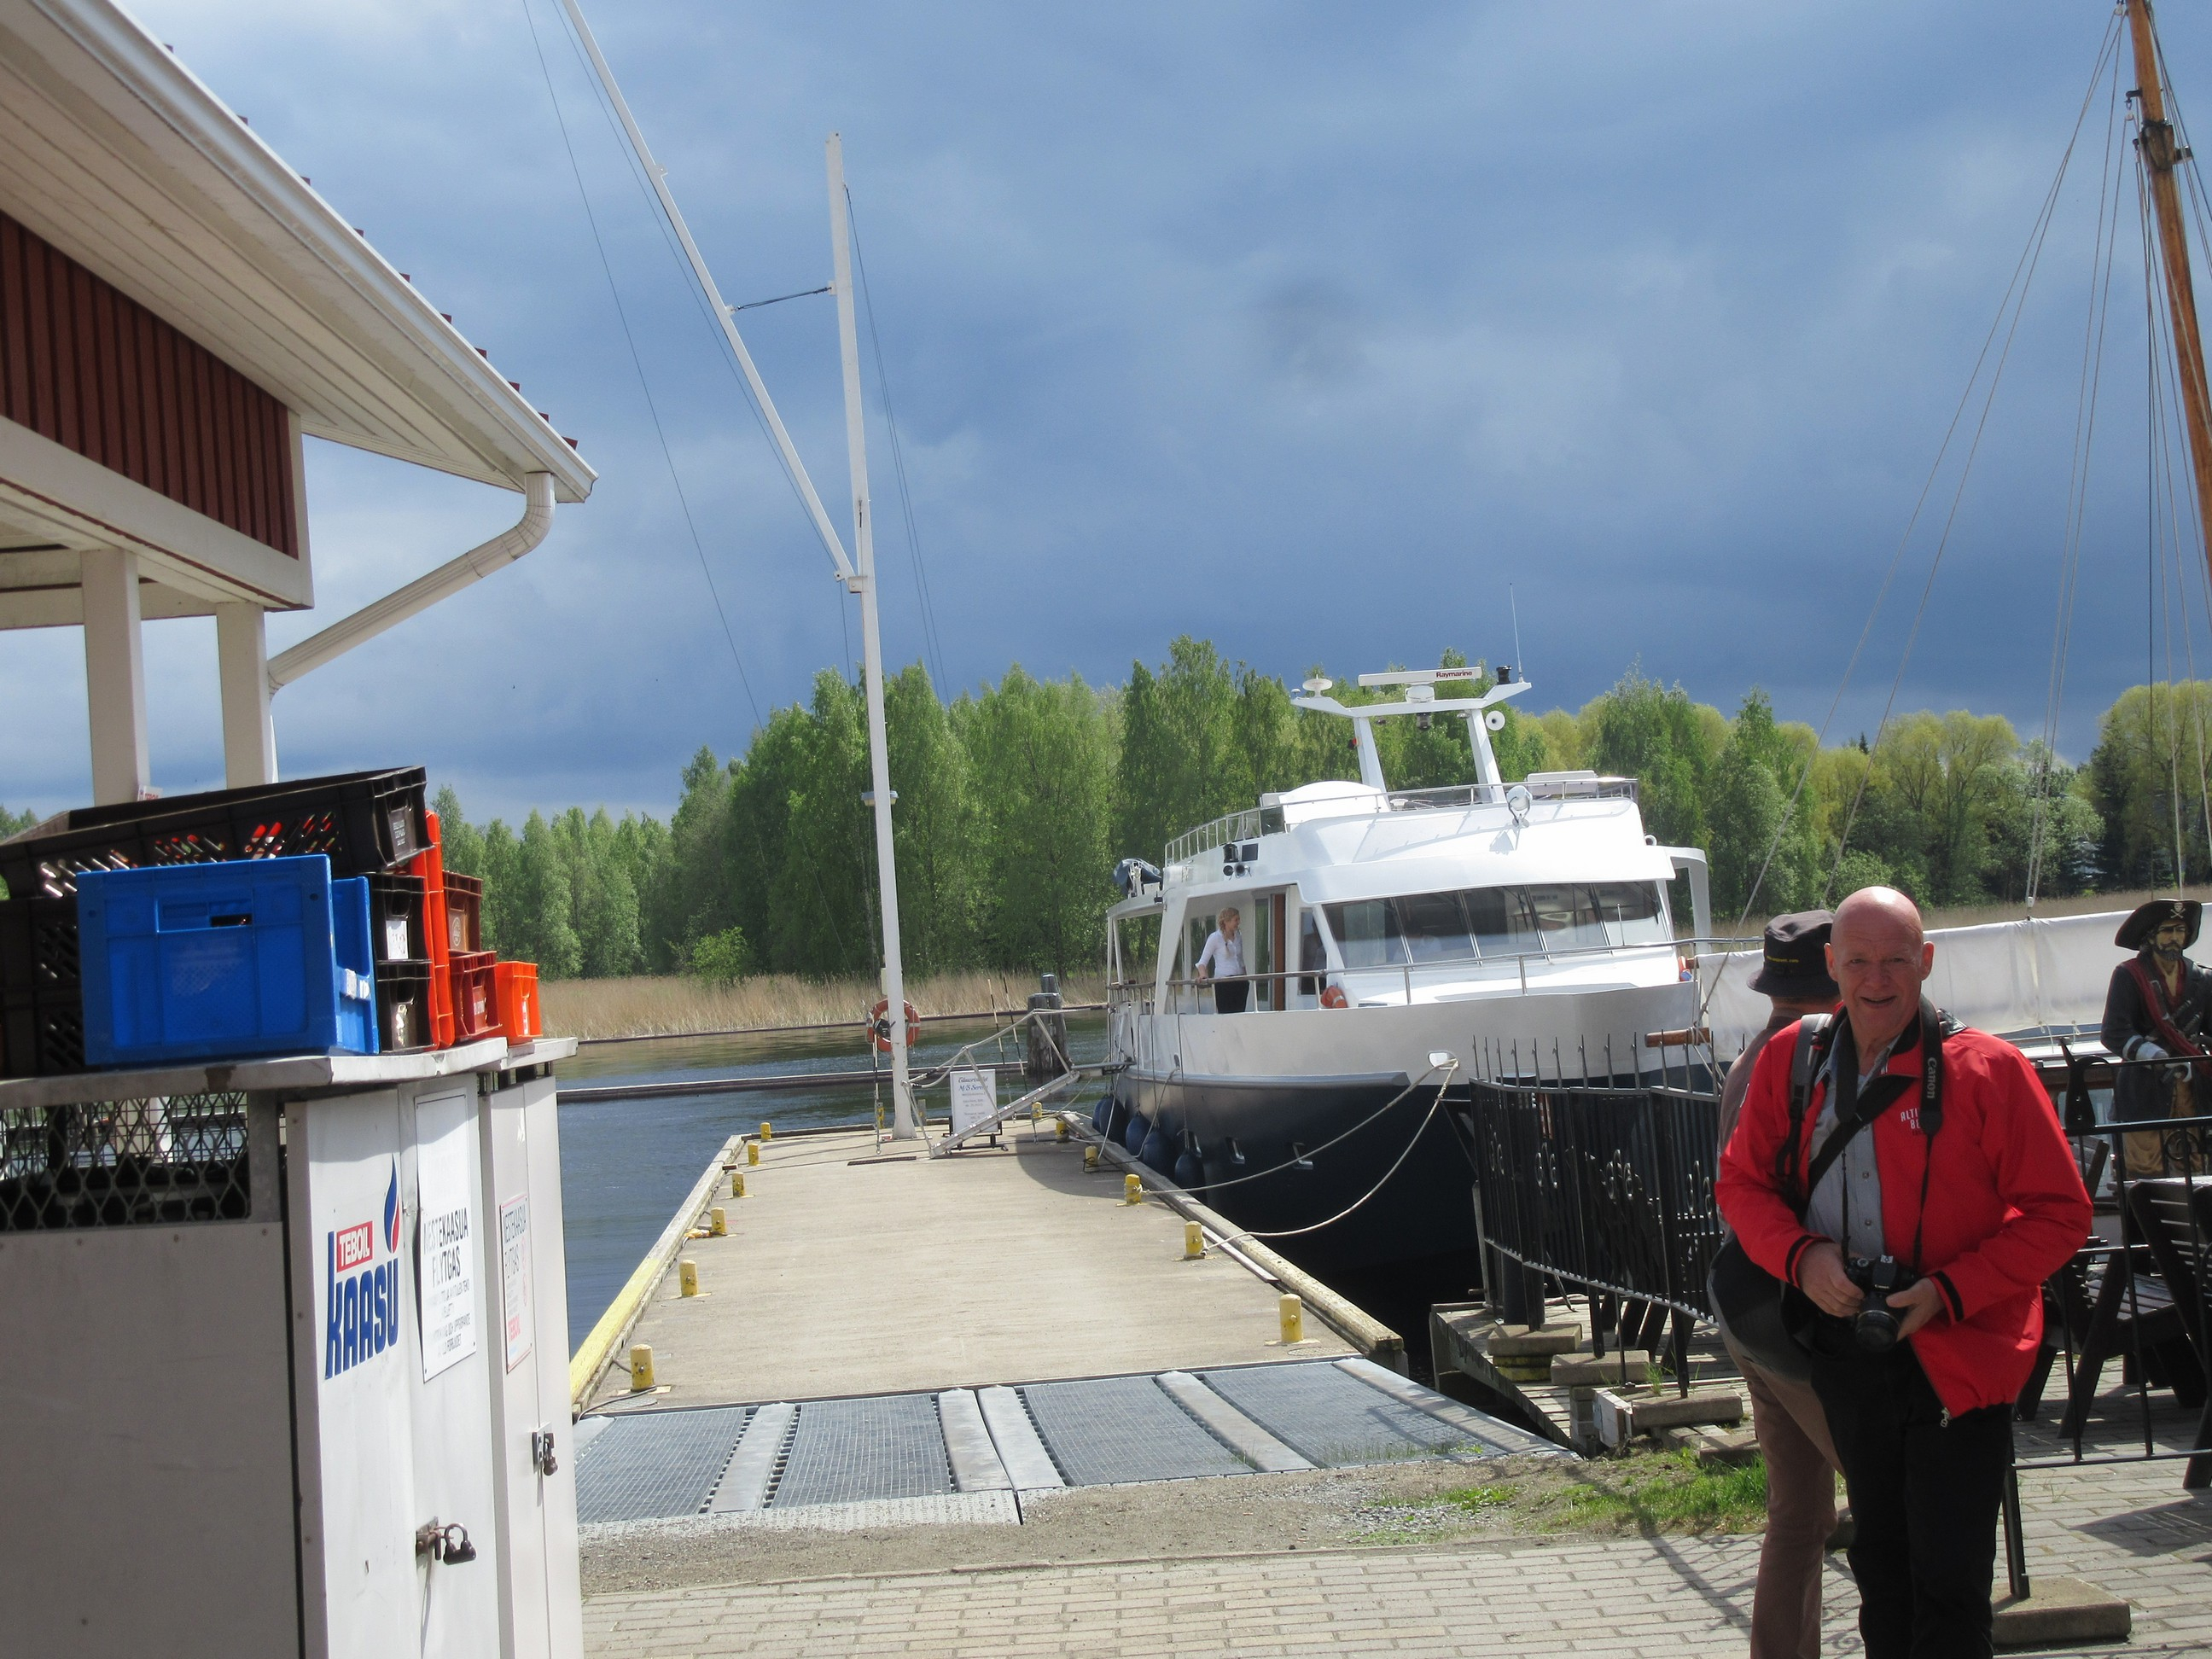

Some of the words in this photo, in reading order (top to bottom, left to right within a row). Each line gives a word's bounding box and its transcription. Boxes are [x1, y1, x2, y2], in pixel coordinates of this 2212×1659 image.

[1436, 670, 1473, 678] Raymarine
[1927, 1057, 1937, 1099] Canon
[1901, 1108, 1918, 1122] ALTI
[339, 1225, 370, 1267] TEBOIL
